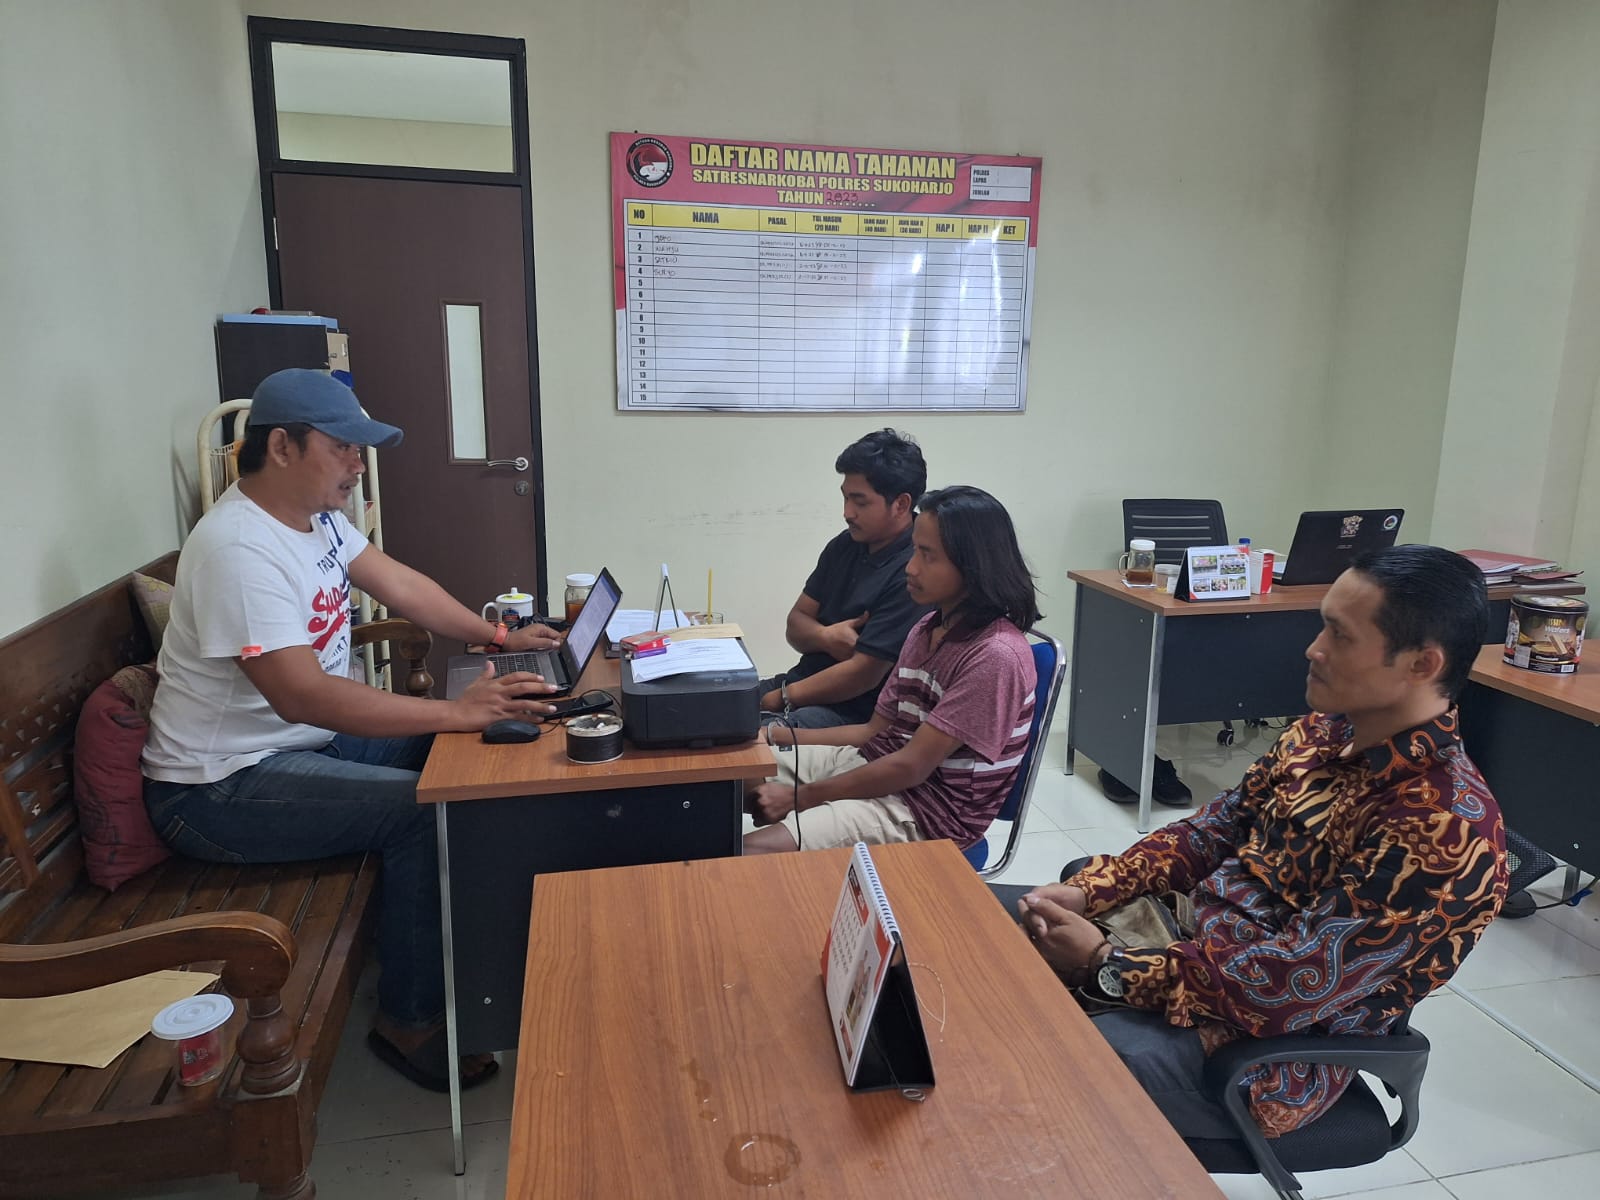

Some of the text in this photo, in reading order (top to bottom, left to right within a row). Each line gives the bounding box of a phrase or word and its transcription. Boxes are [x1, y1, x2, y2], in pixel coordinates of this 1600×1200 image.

[690, 142, 779, 171] DAFTAR
[784, 148, 851, 175] NAMA
[853, 153, 956, 180] TAHANAN
[692, 169, 954, 195] SATRESNARKOBA POLRES SUKOHARJO
[777, 190, 824, 205] TAHUN
[826, 191, 859, 202] 2023
[633, 209, 645, 220] NO
[692, 211, 720, 224] NAMA
[767, 216, 788, 226] PASAL
[935, 223, 951, 233] HAP
[1003, 225, 1016, 235] KET
